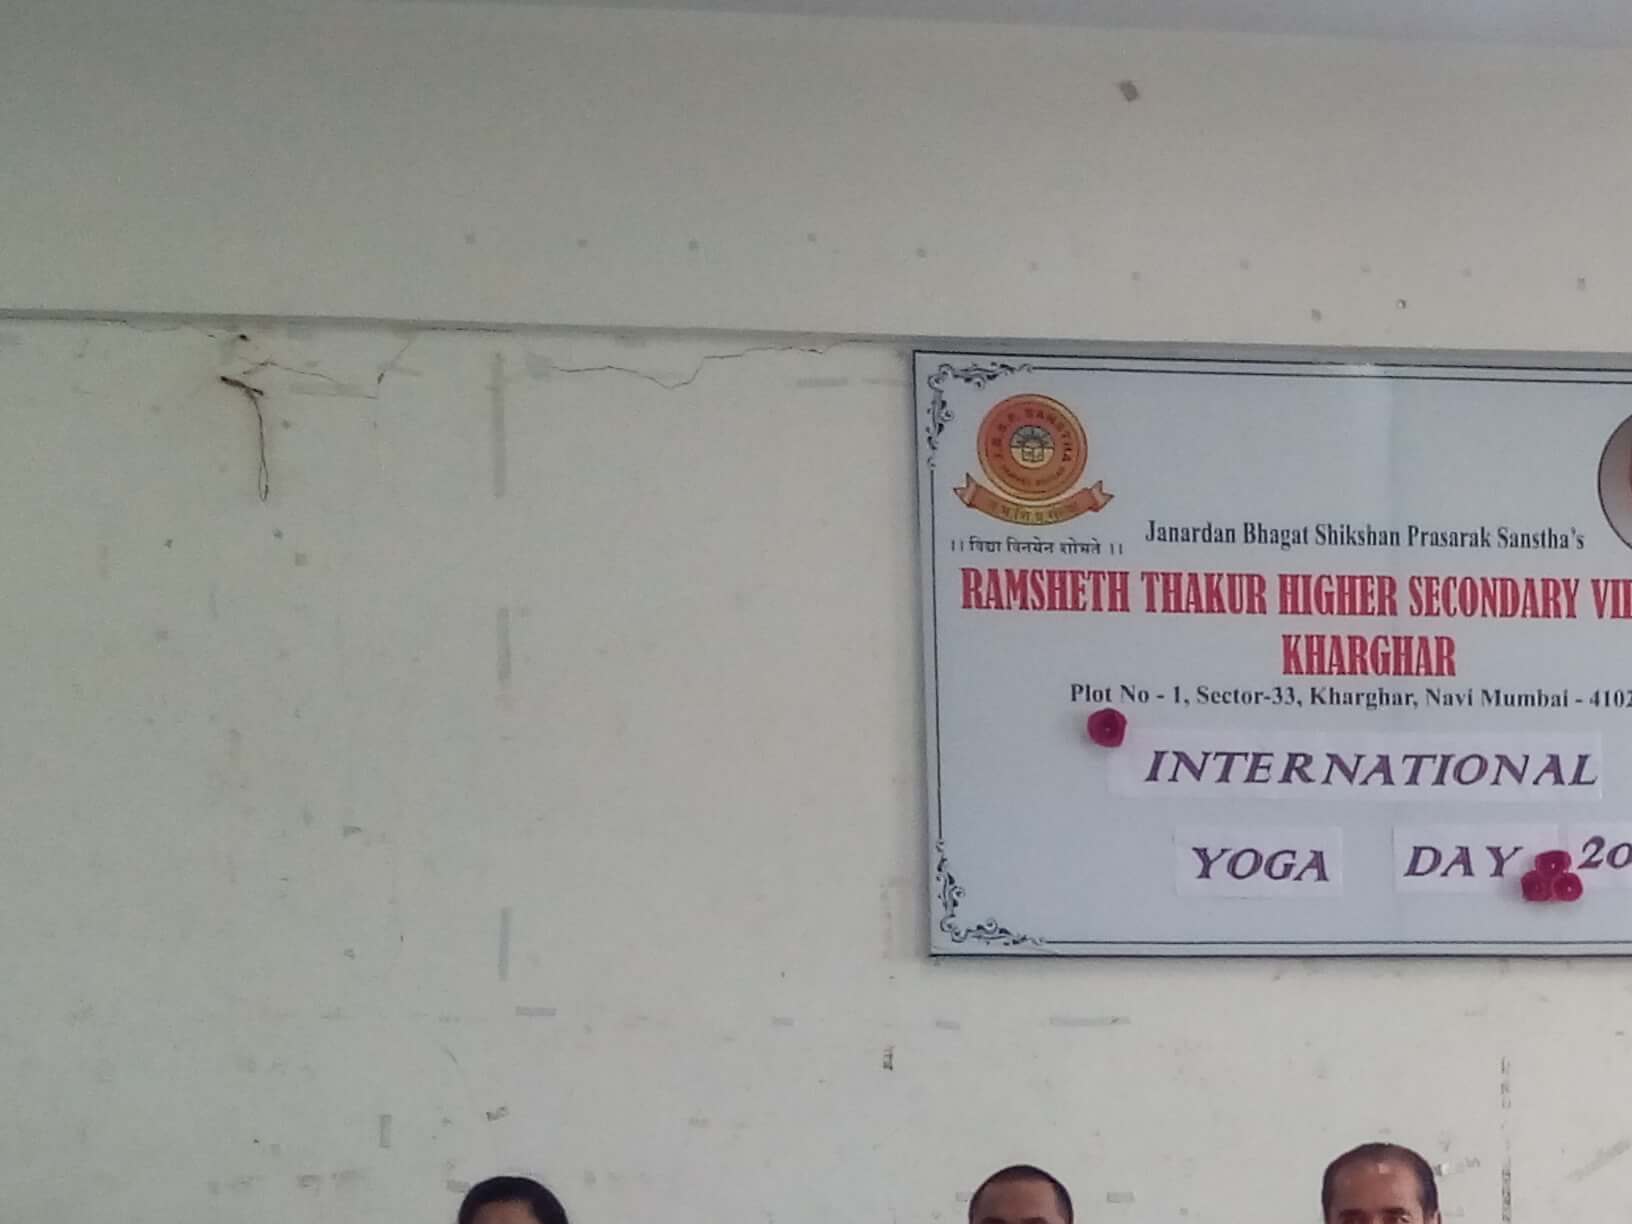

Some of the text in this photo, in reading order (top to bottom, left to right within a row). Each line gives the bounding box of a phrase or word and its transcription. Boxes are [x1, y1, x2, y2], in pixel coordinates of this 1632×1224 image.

[1007, 536, 1054, 554] विनयेन
[1145, 519, 1585, 551] Janardan Bhagat Shikshan Prasarak Sanstha's
[961, 568, 1130, 612] RAMSHETH
[1141, 571, 1267, 615] THAKUR
[1278, 574, 1397, 616] HIGHER
[1409, 576, 1579, 619] SECONDARY
[1282, 634, 1456, 677] KHARGHAR
[1071, 683, 1111, 705] Plot
[1119, 685, 1149, 705] No
[1174, 686, 1190, 706] 1,
[1197, 685, 1302, 707] Sector-33,
[1311, 687, 1418, 710] Kharghar,
[1426, 688, 1473, 707] Navi
[1481, 689, 1569, 709] Mumbai
[1144, 750, 1598, 787] INTERNATIONAL
[1192, 847, 1330, 882] YOGA
[1403, 845, 1524, 878] DAY
